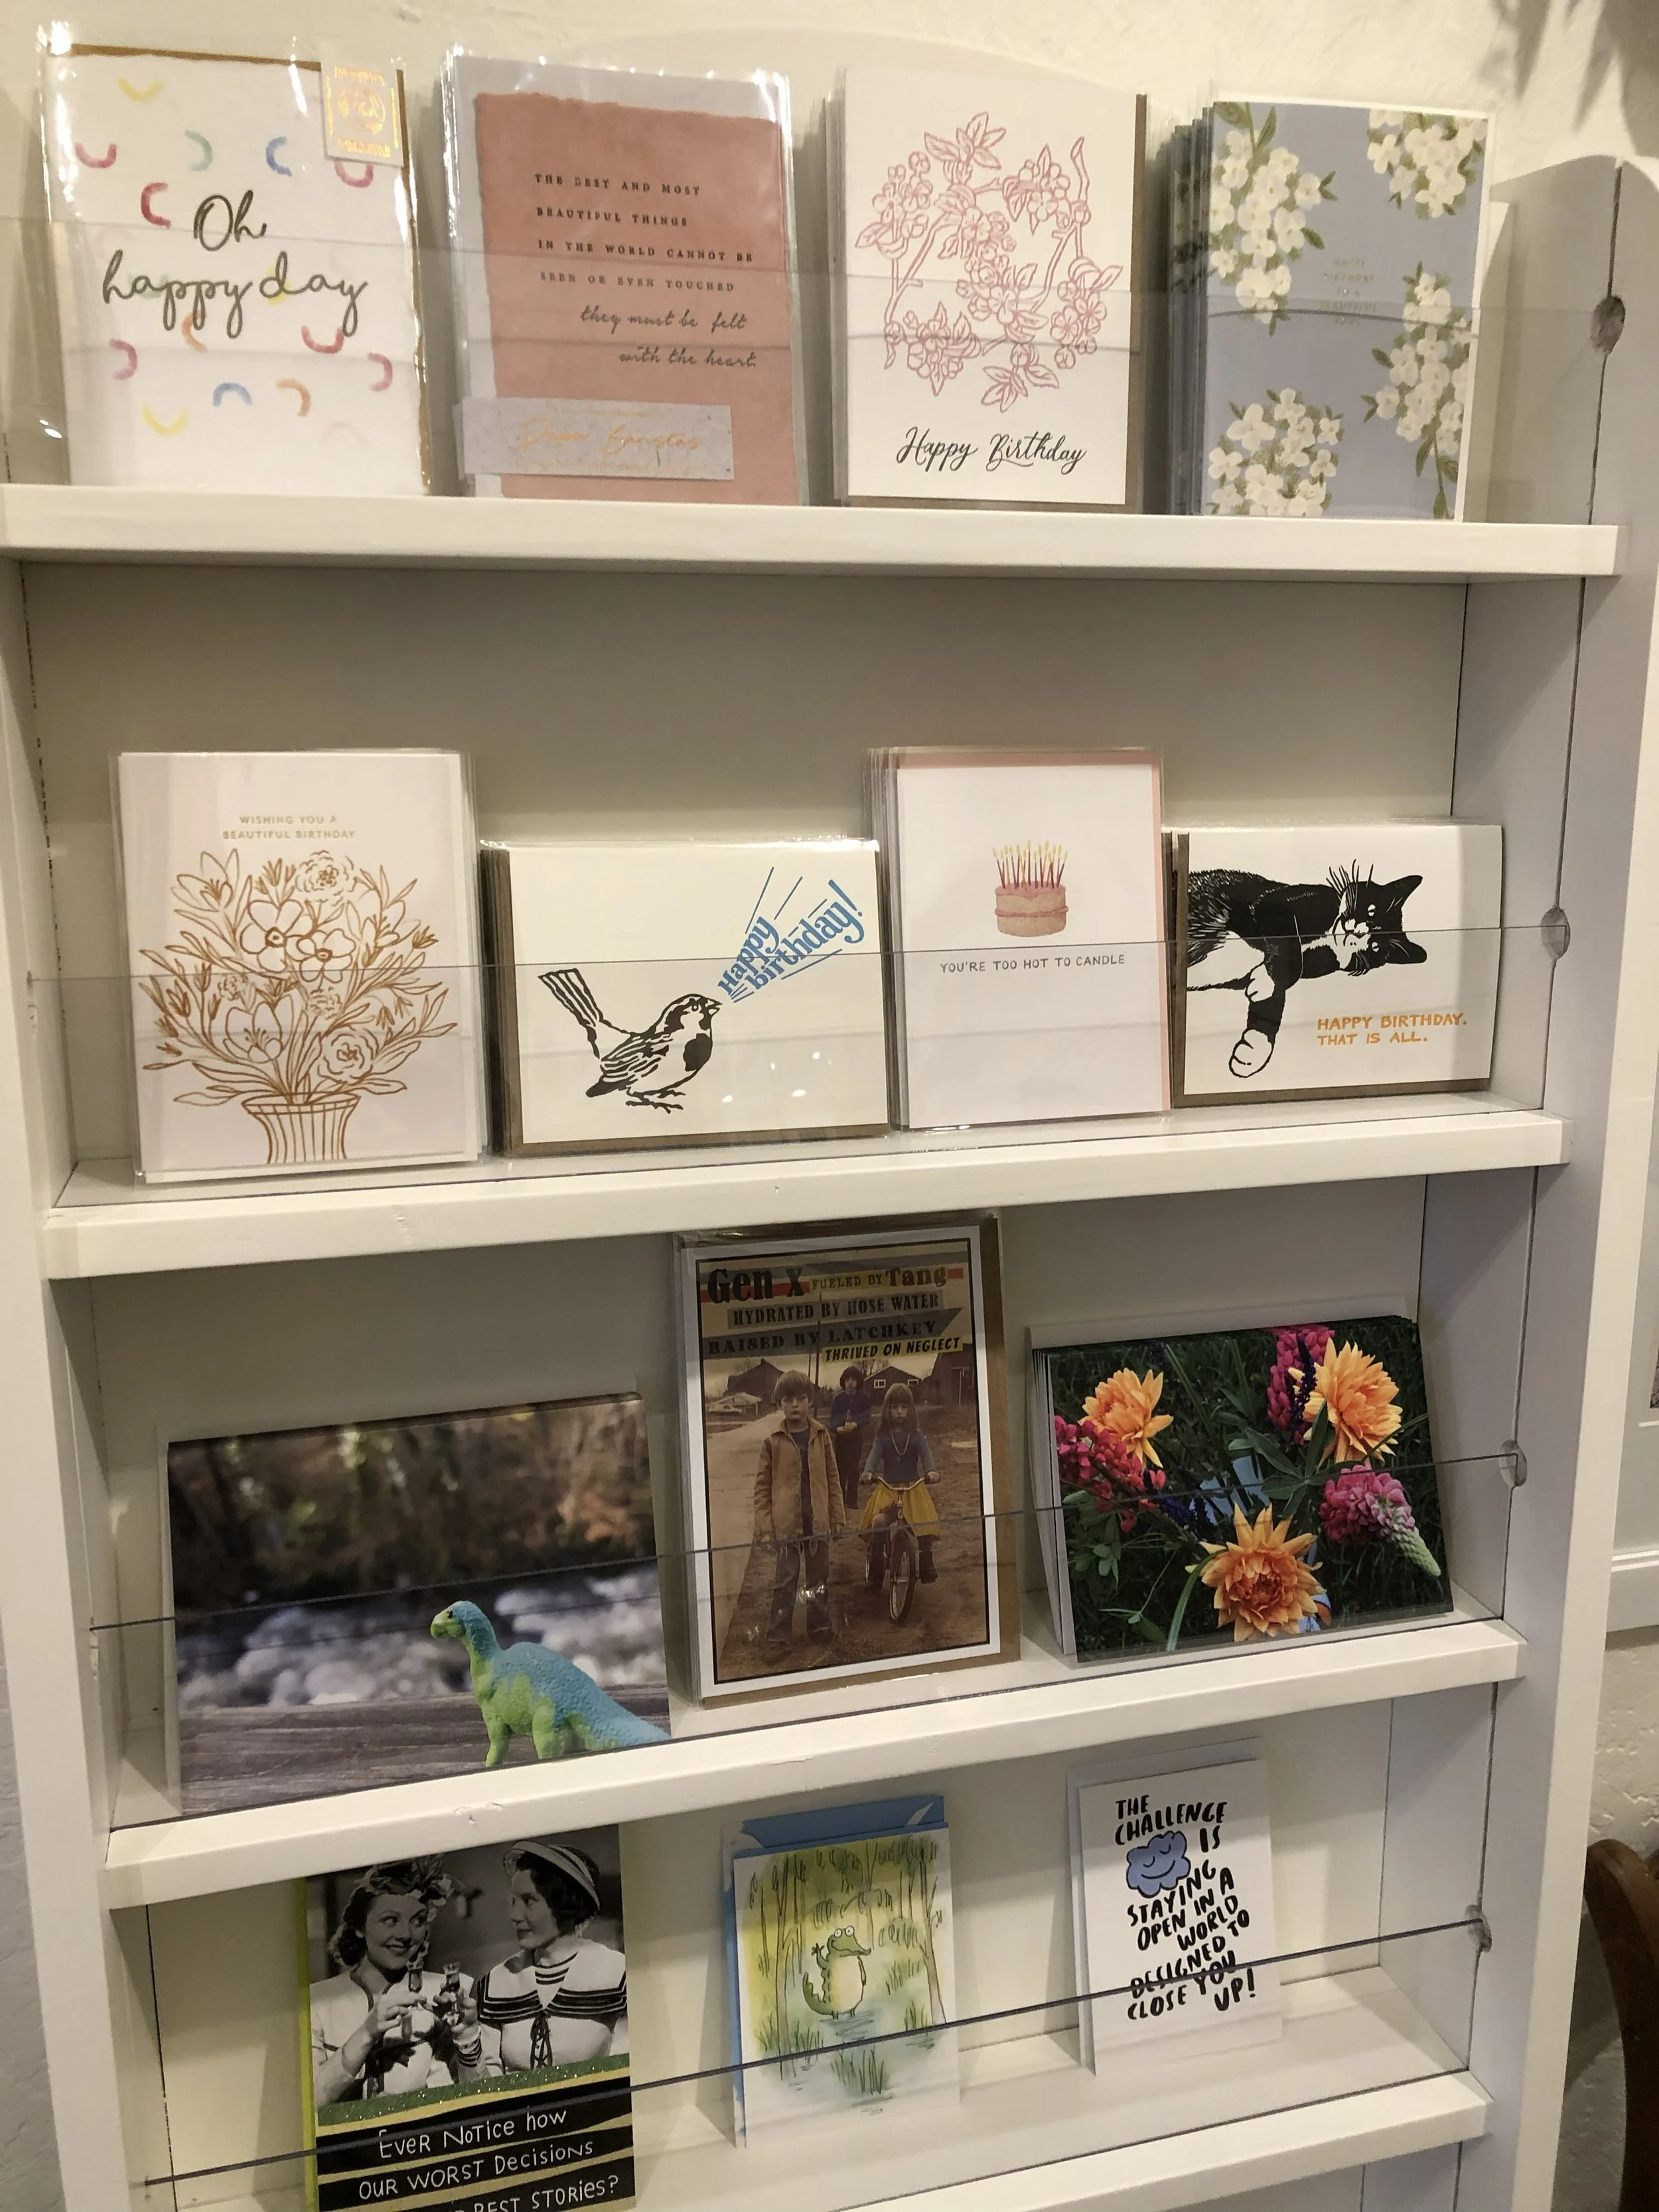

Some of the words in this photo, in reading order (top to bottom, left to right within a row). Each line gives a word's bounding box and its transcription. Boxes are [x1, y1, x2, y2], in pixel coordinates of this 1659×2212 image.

[534, 173, 563, 185] THE
[575, 177, 609, 189] BEST
[622, 181, 650, 192] AND
[662, 183, 700, 196] MOST
[194, 190, 267, 251] Oh
[537, 206, 620, 223] BEAUTIFUL
[632, 214, 687, 227] THINGS
[538, 240, 554, 250] IN
[565, 242, 593, 253] THE
[605, 244, 656, 256] WORLD
[667, 248, 725, 261] CANNOT
[737, 253, 753, 263] BE
[103, 249, 253, 338] happy
[259, 251, 368, 336] day
[540, 271, 576, 283] SEEN
[588, 275, 605, 285] OR
[618, 276, 654, 287] EVEN
[666, 279, 734, 292] TOUCHED
[580, 305, 621, 334] they
[628, 309, 675, 326] must
[679, 309, 698, 327] be
[711, 311, 747, 333] felt
[619, 345, 661, 364] with
[668, 346, 697, 364] the
[896, 426, 978, 472] Happy
[985, 431, 1087, 475] Birthday
[239, 816, 293, 825] WISHING
[299, 816, 325, 824] YOU
[222, 830, 291, 840] BEAUTIFUL
[296, 830, 355, 840] BIRTHDAY
[745, 879, 865, 990] birthday!
[717, 916, 780, 995] Happy
[940, 960, 986, 974] YOU'RE
[993, 959, 1017, 971] TOO
[1023, 958, 1048, 970] HOT
[1054, 956, 1071, 968] TO
[1076, 954, 1125, 966] CANDLE
[1317, 1016, 1373, 1031] HAPPY
[1380, 1013, 1467, 1029] BIRTHDAY.
[1317, 1033, 1357, 1046] THAT
[1366, 1032, 1380, 1044] IS
[1389, 1031, 1428, 1044] ALL.
[707, 1267, 774, 1304] Gen
[785, 1266, 805, 1298] X
[811, 1276, 861, 1290] FUELED
[868, 1274, 883, 1286] BY
[885, 1266, 948, 1288] Tang
[733, 1304, 814, 1326] HYDRATED
[821, 1301, 840, 1319] BY
[847, 1297, 885, 1315] HOSE
[891, 1293, 939, 1311] WATER
[708, 1334, 784, 1355] RAISED
[793, 1331, 820, 1347] BY
[828, 1319, 937, 1344] LATCHKEY
[825, 1345, 879, 1363] THRIVED
[883, 1343, 901, 1356] ON
[906, 1337, 961, 1353] NEGLECT
[1115, 1795, 1149, 1820] THE
[1115, 1802, 1228, 1846] CHALLENGE
[1199, 1825, 1221, 1853] IS
[1127, 1859, 1216, 1927] STAYING
[1137, 1909, 1186, 1951] OPEN
[1194, 1888, 1215, 1916] IN
[1220, 1867, 1234, 1895] A
[1177, 1895, 1238, 1951] WORLD
[1129, 1935, 1226, 1999] DESIGNED
[1227, 1909, 1250, 1937] TO
[1127, 1984, 1187, 2020] CLOSE
[1193, 1950, 1236, 1996] YOU
[1214, 1968, 1256, 2012] UP!
[526, 2105, 567, 2132] how
